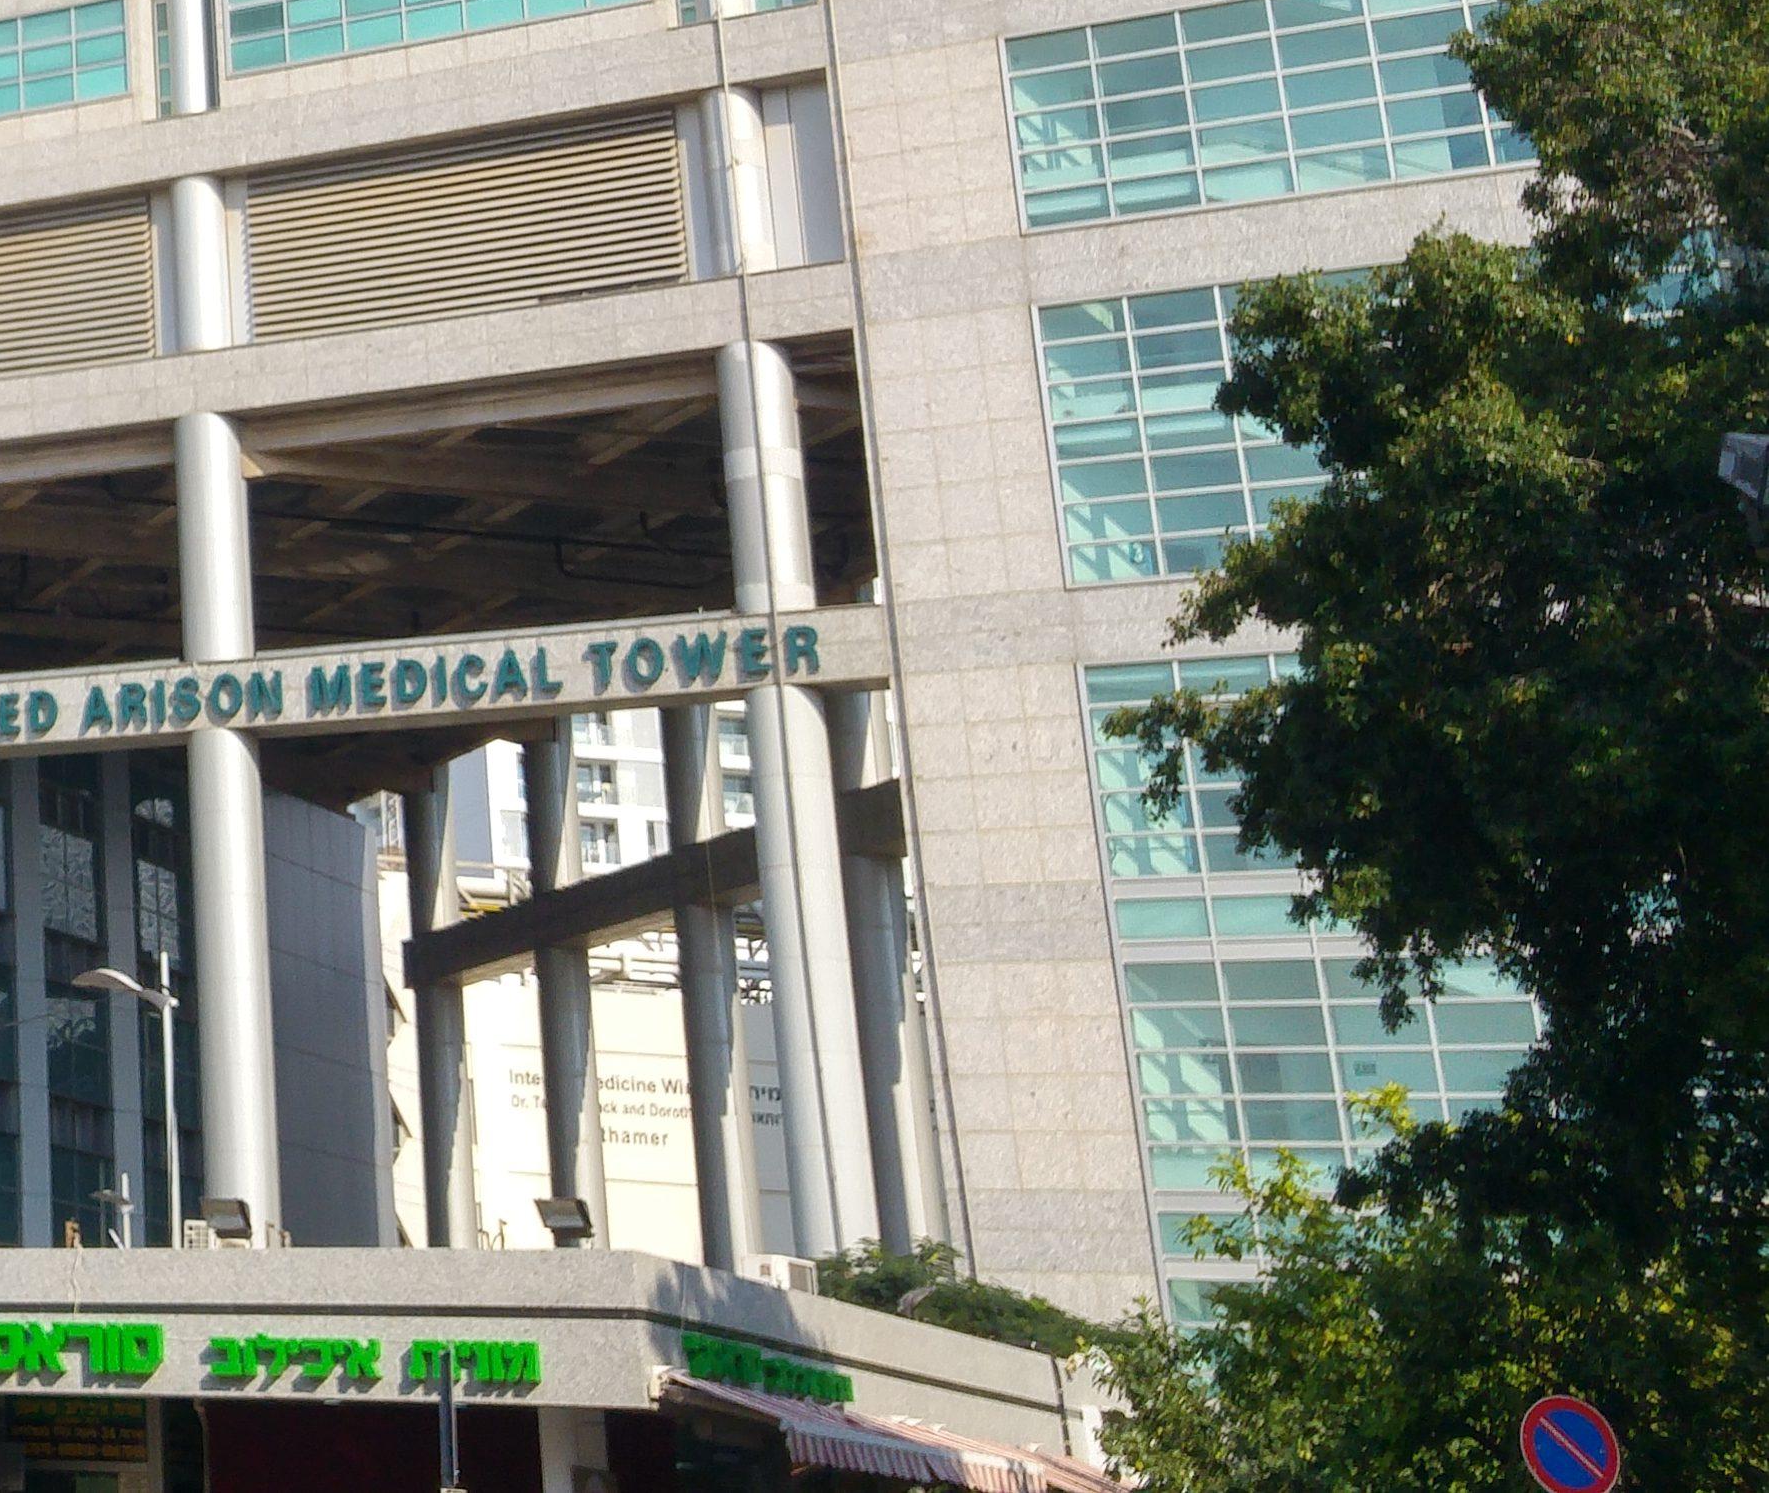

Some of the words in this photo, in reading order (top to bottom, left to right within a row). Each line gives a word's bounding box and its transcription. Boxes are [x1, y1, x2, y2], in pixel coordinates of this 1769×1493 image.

[84, 671, 284, 730] ARISON
[307, 647, 561, 711] MEDICAL
[589, 625, 819, 689] TOWER
[508, 1068, 543, 1086] Inte
[597, 1074, 657, 1093] edicine
[661, 1077, 691, 1096] Wi
[622, 1103, 645, 1116] and
[601, 1125, 669, 1146] thamer
[209, 1333, 382, 1378] איכילוב
